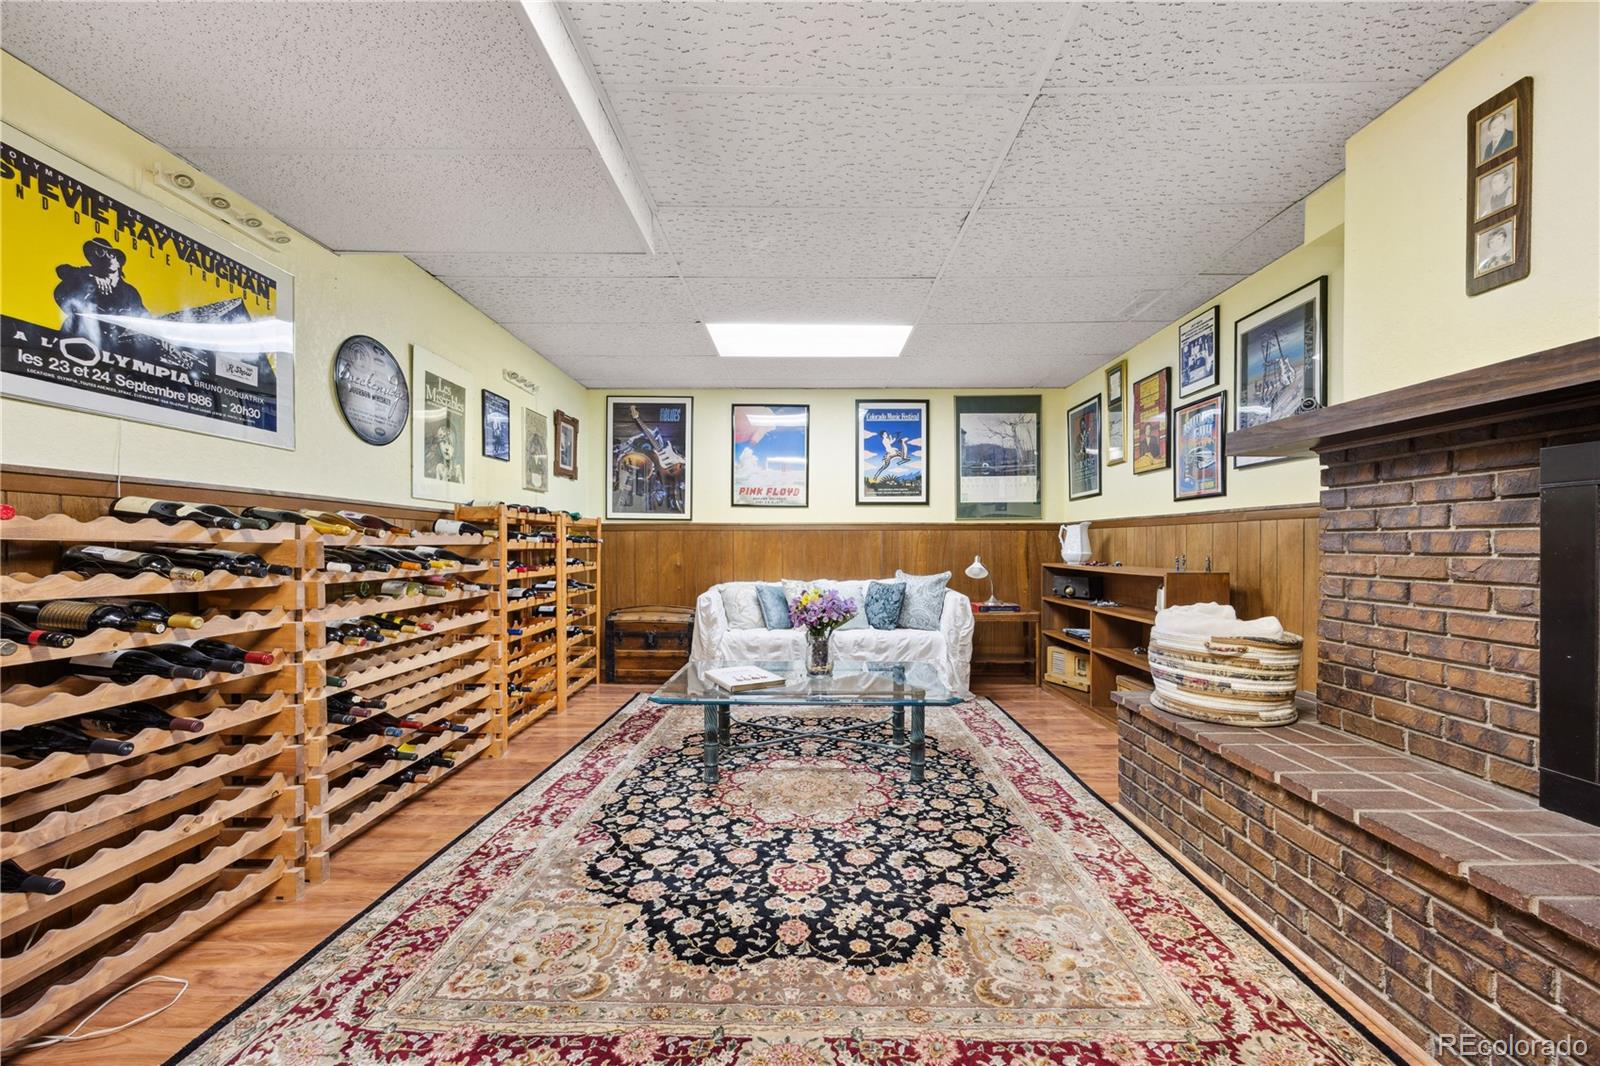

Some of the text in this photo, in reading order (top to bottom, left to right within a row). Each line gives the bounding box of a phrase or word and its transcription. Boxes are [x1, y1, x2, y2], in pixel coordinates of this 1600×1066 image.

[0, 157, 271, 301] STEVIE RAY VAUGHAN
[98, 194, 113, 207] ET
[127, 209, 142, 222] LE
[154, 223, 199, 250] PALACE
[74, 210, 171, 267] DOUBLE
[188, 263, 271, 311] TROUBLE
[18, 348, 44, 367] les
[48, 357, 71, 374] 23
[72, 364, 90, 378] et
[92, 368, 112, 384] 24
[115, 373, 186, 402] Septembre
[187, 392, 213, 408] 1986
[230, 402, 261, 419] 20h30
[194, 379, 265, 404] BRUNO COQUATRIX
[437, 377, 452, 396] Les
[866, 412, 920, 420] Colorado Music Festival
[738, 487, 800, 497] PINK FLOYD
